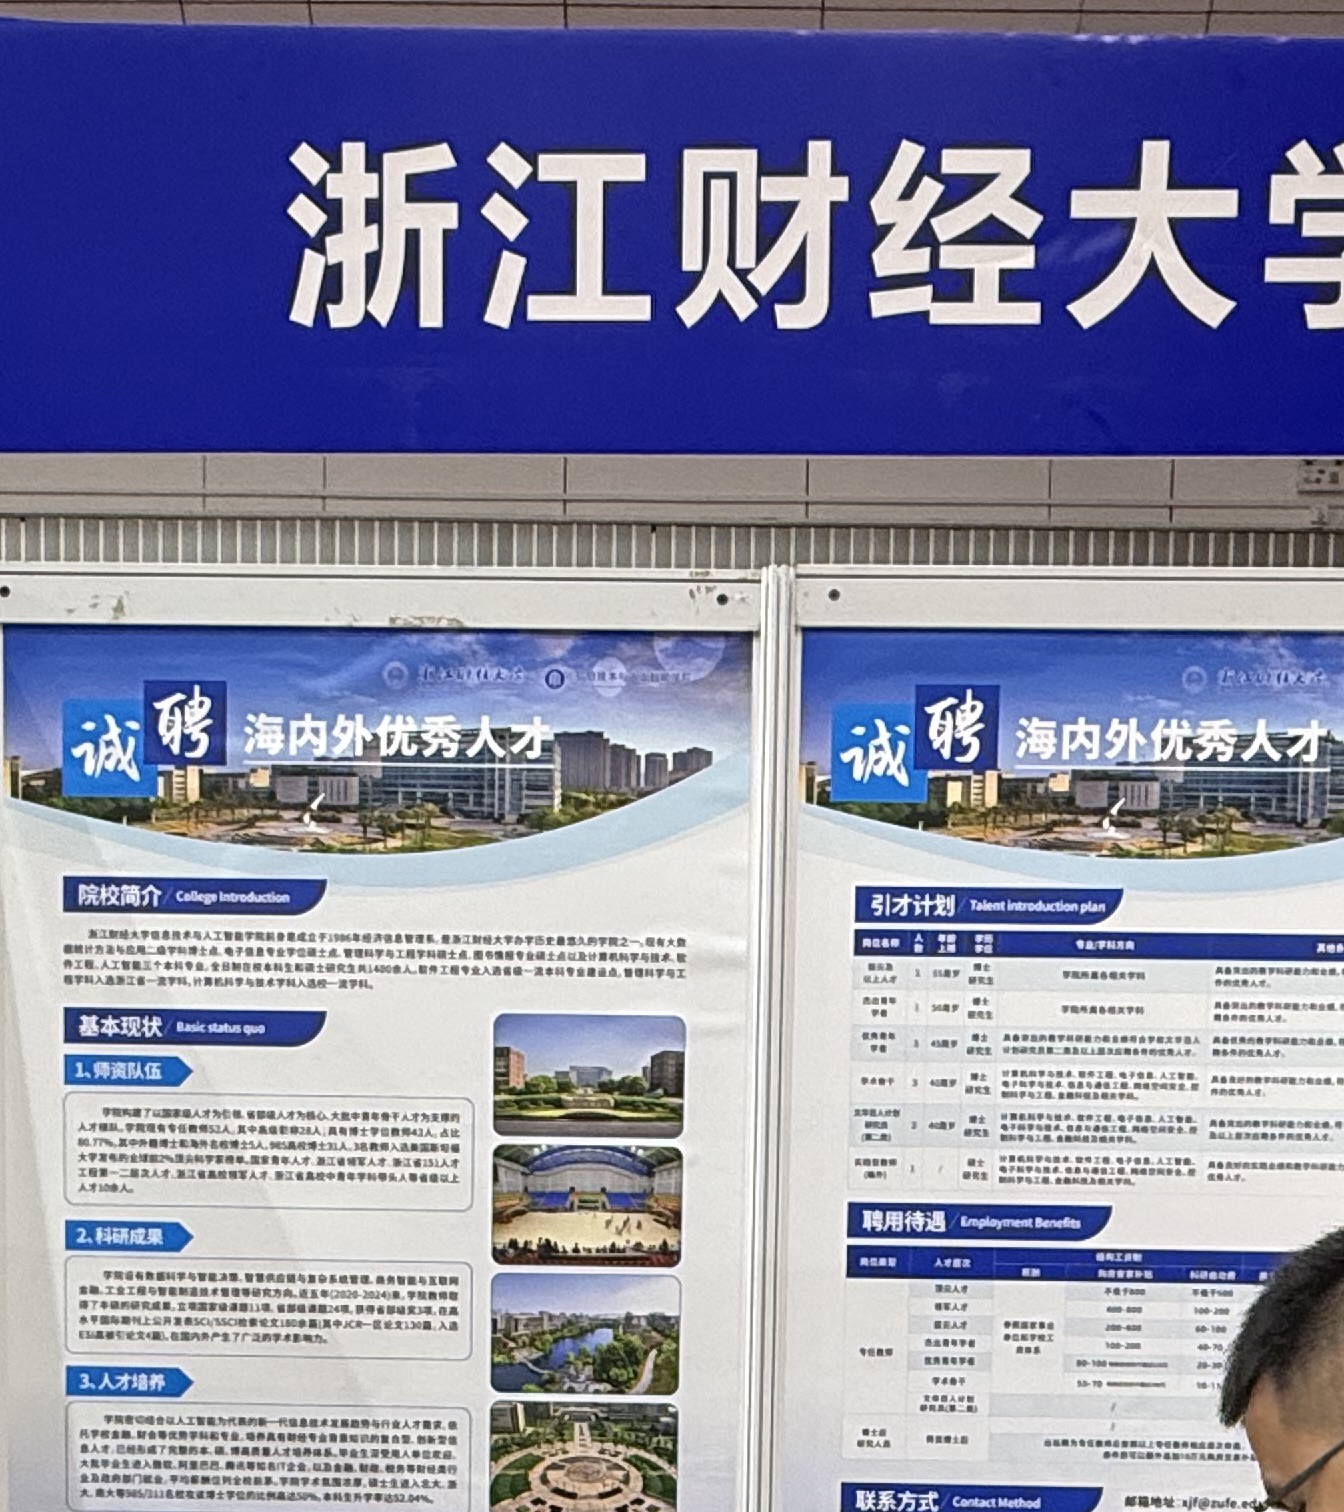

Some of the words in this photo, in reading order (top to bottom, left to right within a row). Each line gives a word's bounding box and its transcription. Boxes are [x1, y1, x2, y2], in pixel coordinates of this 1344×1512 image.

[244, 713, 553, 760] 海内外优秀人才
[1015, 717, 1328, 762] 海内外优秀人才
[78, 883, 162, 909] 院校简介
[176, 889, 217, 907] College
[219, 889, 290, 905] Introduction
[871, 892, 956, 918] 引才计划
[969, 898, 1004, 914] Talent
[1007, 898, 1076, 914] introduction
[1080, 901, 1106, 917] plan
[79, 1014, 163, 1038] 基本现状
[177, 1020, 206, 1034] Basic
[208, 1021, 241, 1034] status
[243, 1023, 266, 1036] quo
[862, 1209, 947, 1233] 聘用待遇
[960, 1216, 1034, 1231] Employment
[1035, 1217, 1082, 1230] Benefits
[952, 1496, 997, 1510] Contact
[998, 1497, 1042, 1511] Method
